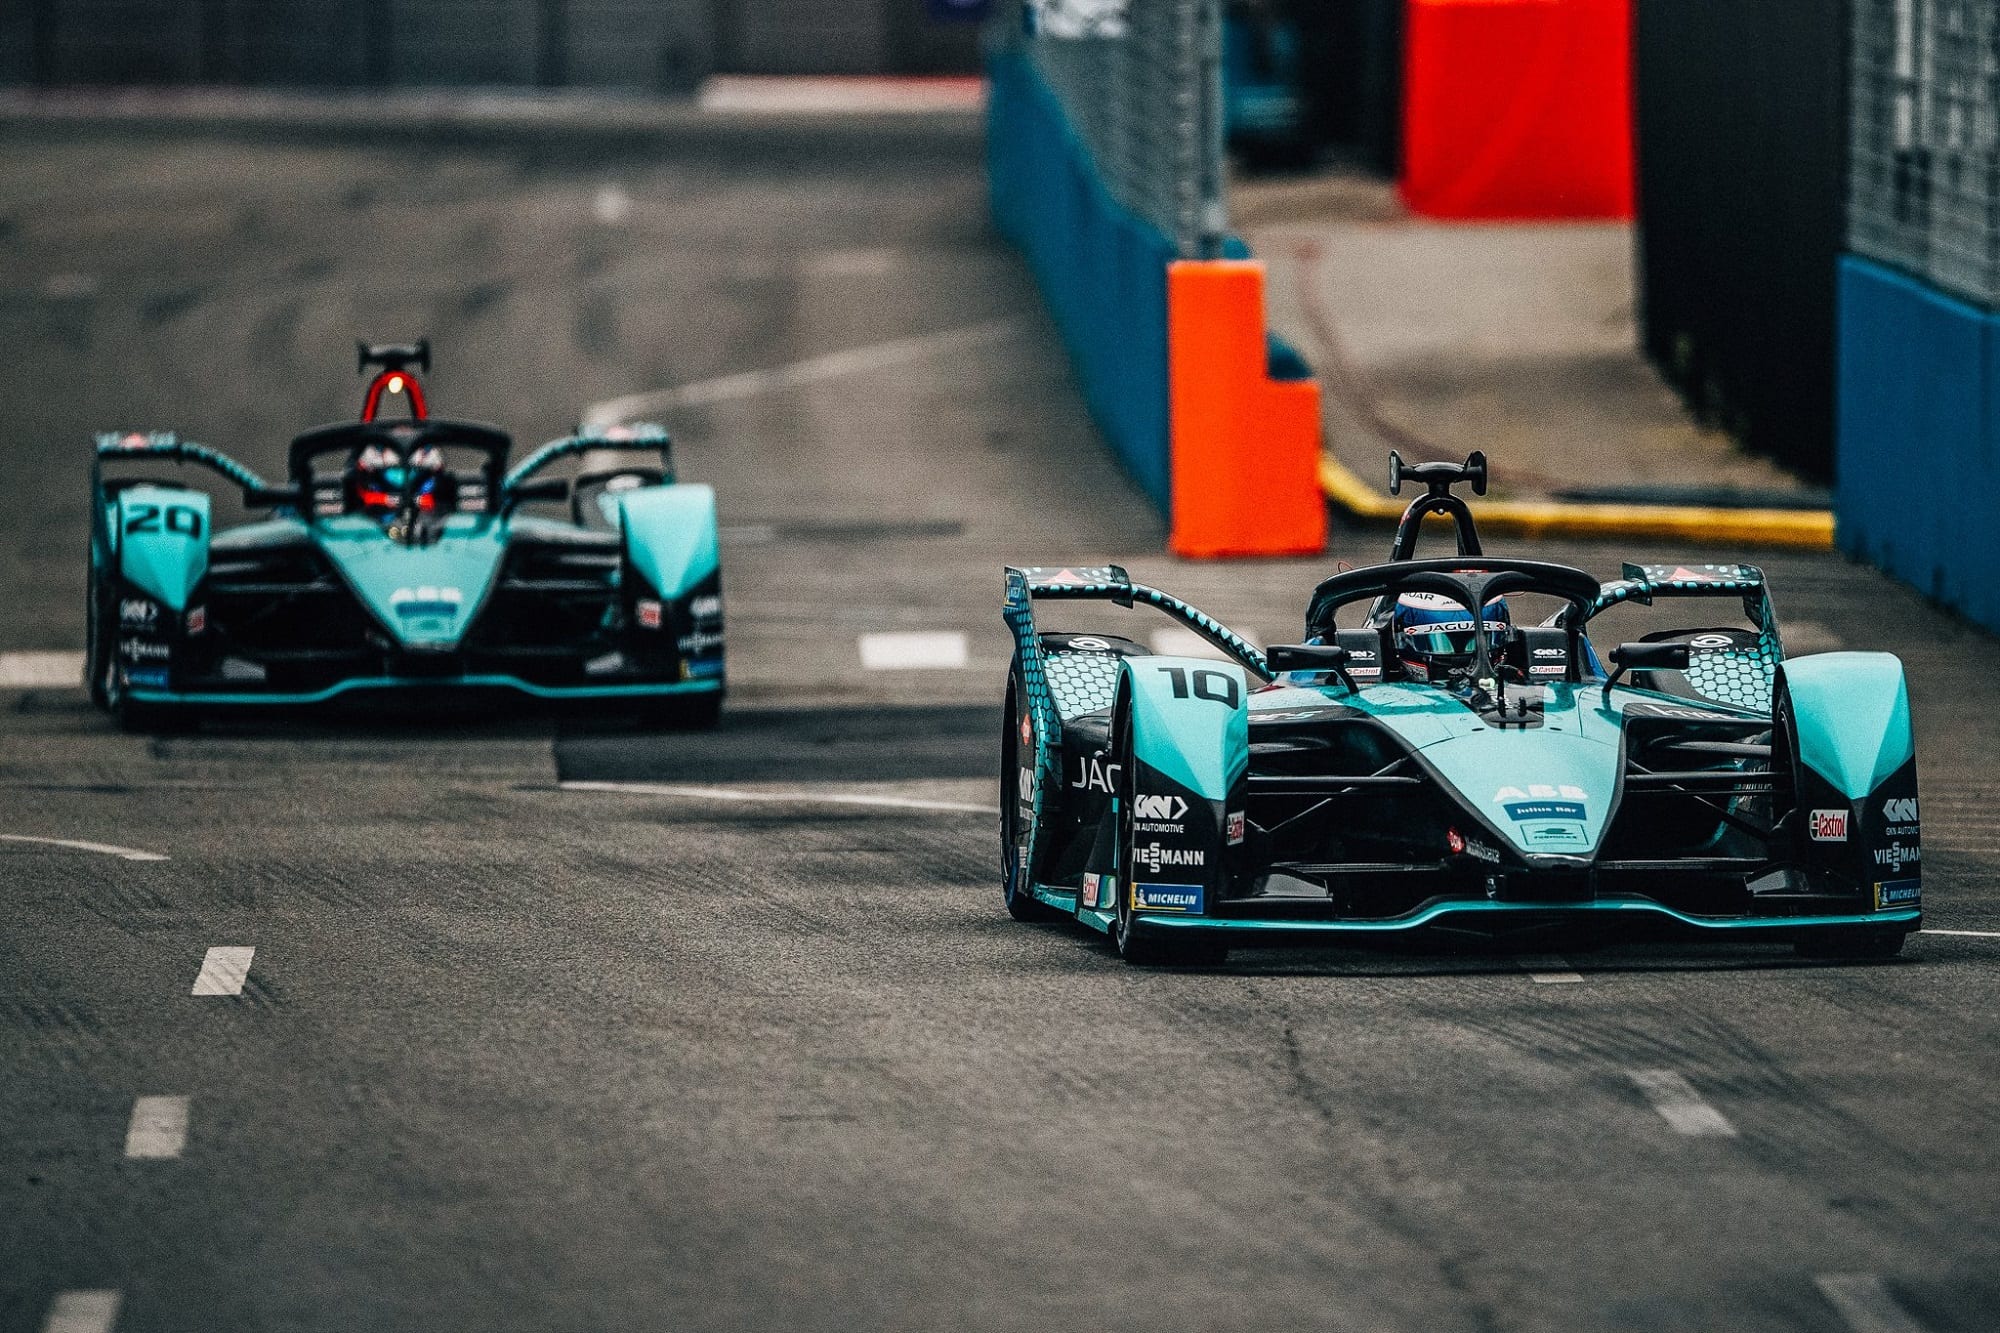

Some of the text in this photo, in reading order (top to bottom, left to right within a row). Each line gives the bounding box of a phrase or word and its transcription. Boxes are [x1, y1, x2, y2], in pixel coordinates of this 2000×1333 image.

[127, 504, 202, 539] 20
[1158, 667, 1239, 710] 10
[1516, 805, 1552, 814] Julius
[1141, 823, 1184, 833] AUTOMOTIVE
[1819, 813, 1846, 837] Castrol
[1147, 893, 1197, 905] MICHELIN
